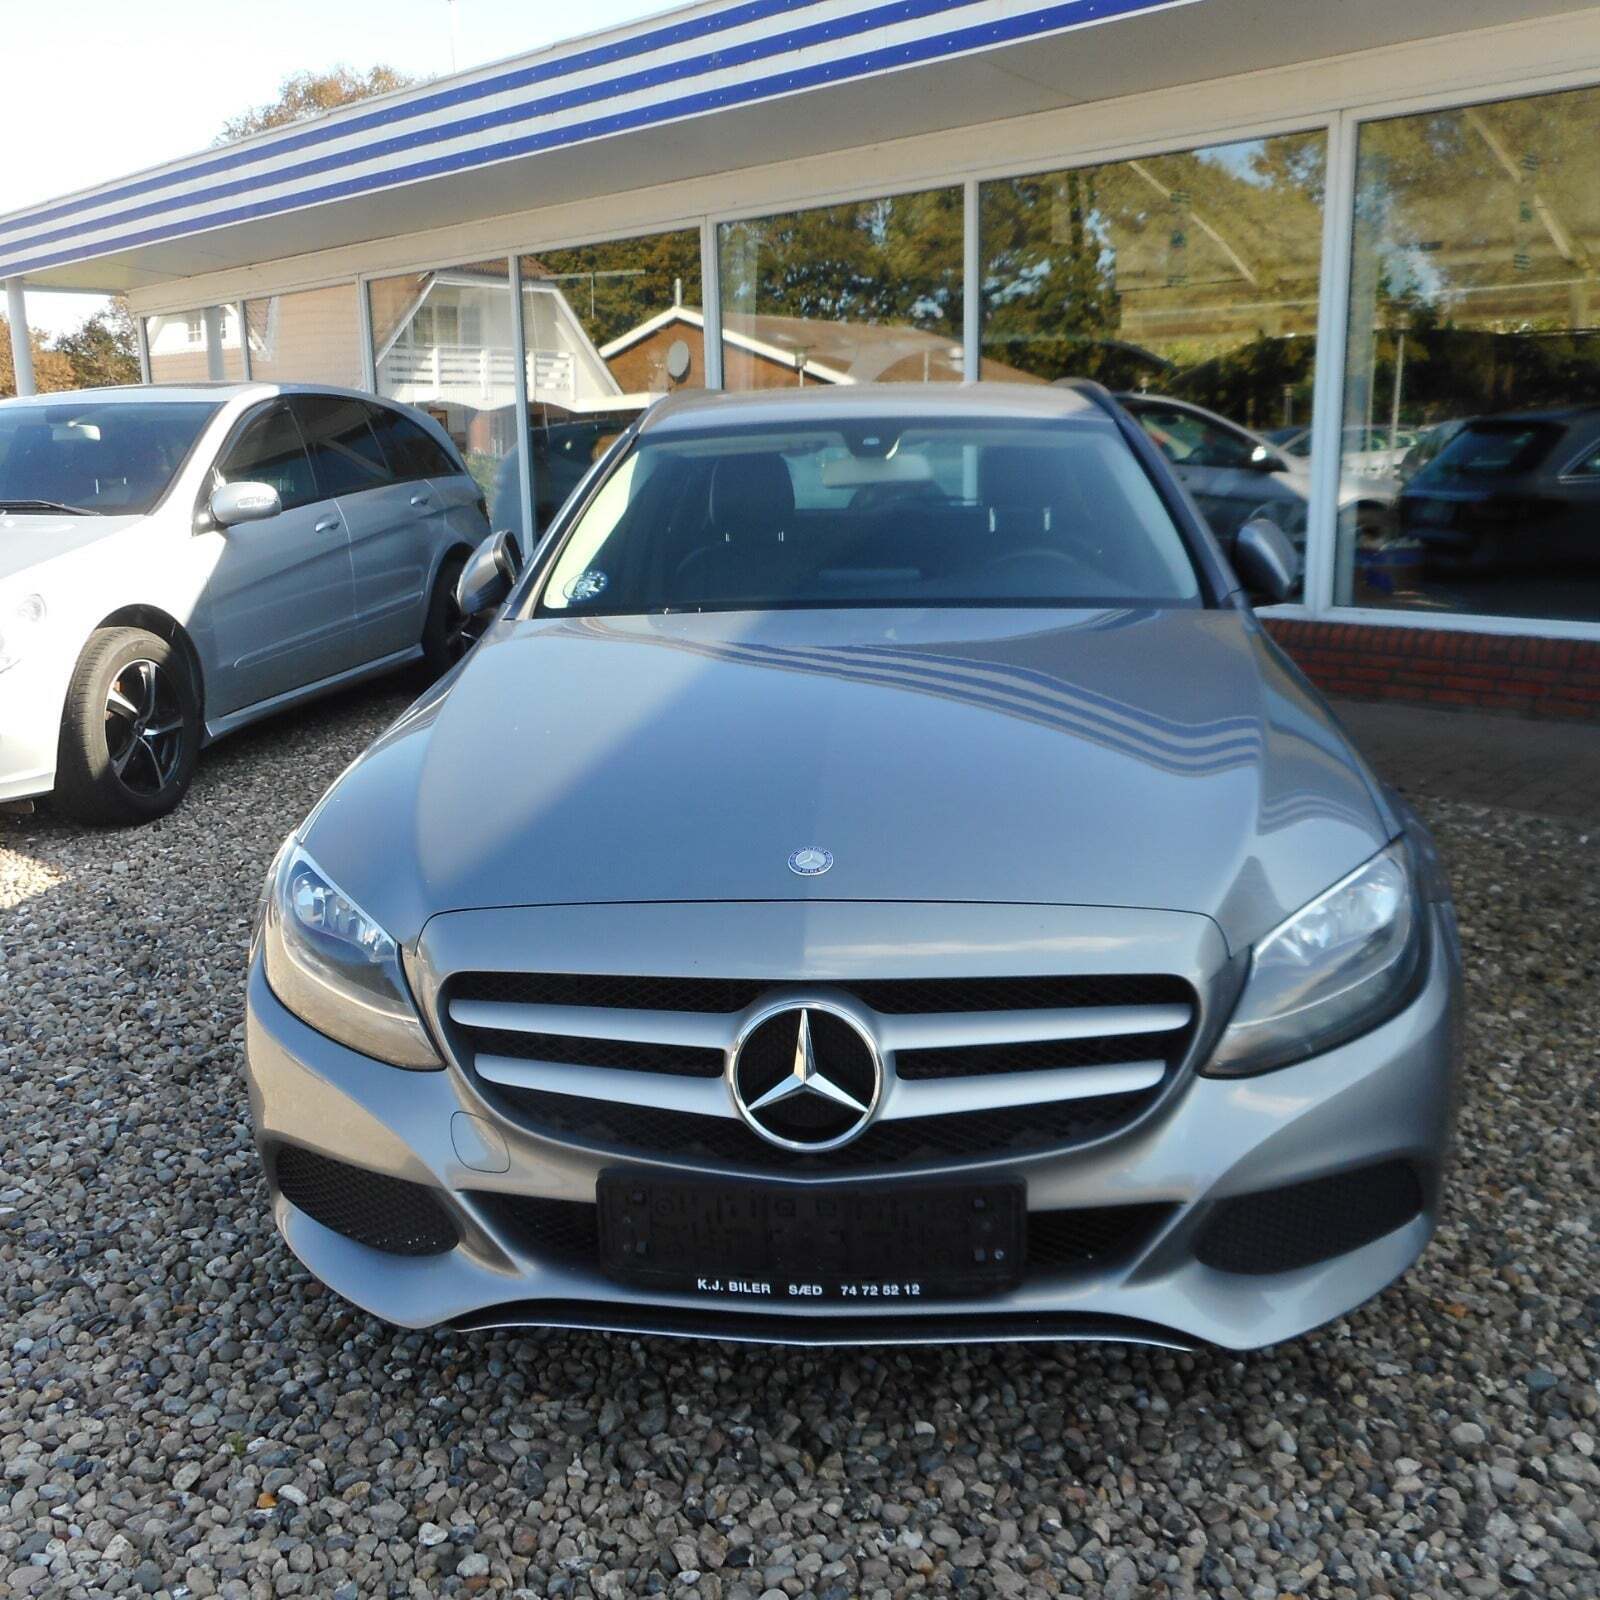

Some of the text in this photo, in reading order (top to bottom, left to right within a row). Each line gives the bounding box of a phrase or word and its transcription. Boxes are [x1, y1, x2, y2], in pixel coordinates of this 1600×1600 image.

[697, 1278, 724, 1291] K.J.
[728, 1281, 771, 1294] BILER
[788, 1284, 823, 1296] SÆD
[840, 1285, 858, 1296] 74
[861, 1284, 879, 1296] 72
[903, 1283, 920, 1295] 12
